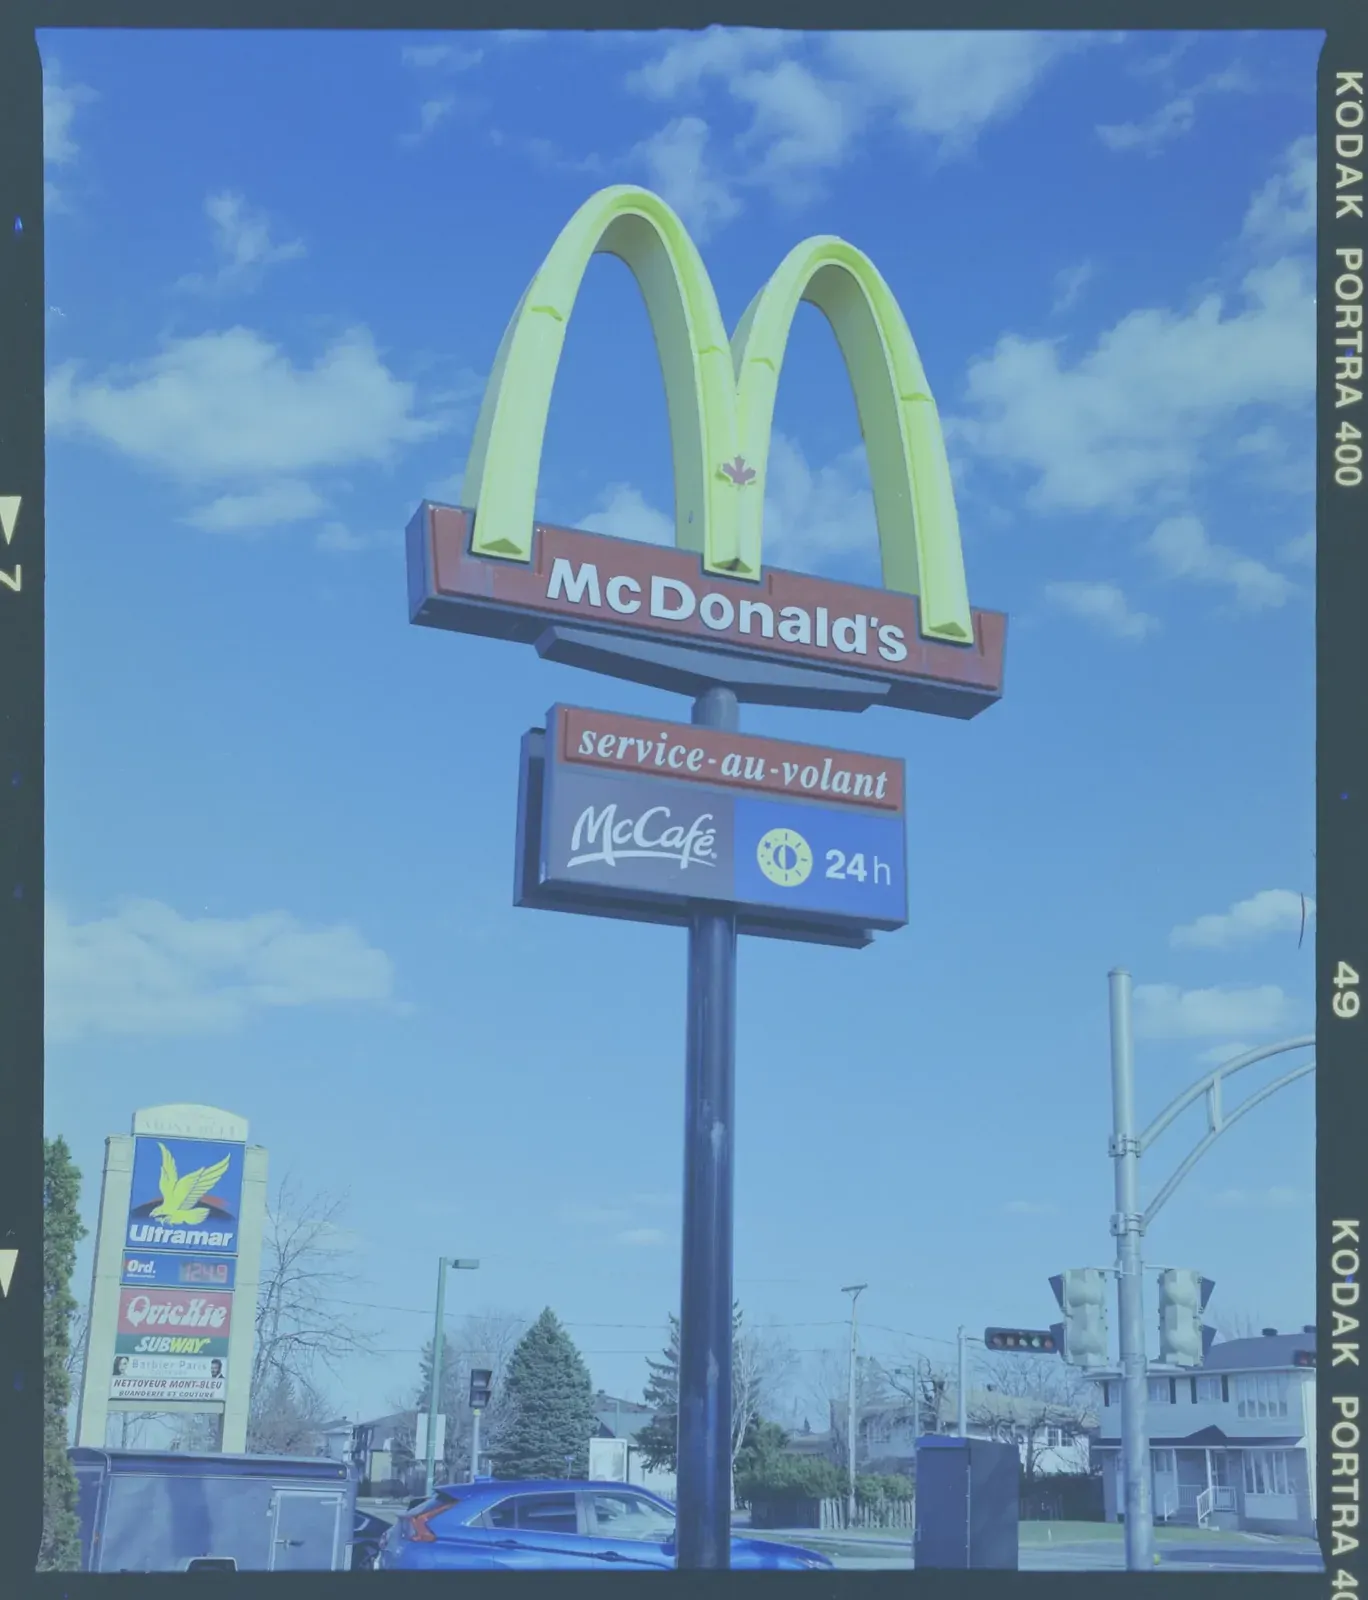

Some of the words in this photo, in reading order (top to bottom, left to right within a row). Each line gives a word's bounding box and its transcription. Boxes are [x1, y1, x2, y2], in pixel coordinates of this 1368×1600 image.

[1335, 71, 1363, 219] KODAK
[1335, 248, 1363, 408] PORTRA
[1335, 421, 1362, 487] 400
[546, 557, 909, 663] McDonald's
[578, 730, 889, 801] service-au-volant
[570, 804, 717, 869] McCafé
[1332, 962, 1361, 1019] 49
[127, 1259, 156, 1274] Ord.
[129, 1224, 234, 1247] Ultramar
[1332, 1220, 1361, 1367] KODAK
[134, 1336, 211, 1353] SUBWAY
[113, 1379, 167, 1388] NETTOYEUR
[169, 1380, 223, 1389] MONT-BLEU
[1332, 1396, 1361, 1555] PORTRA
